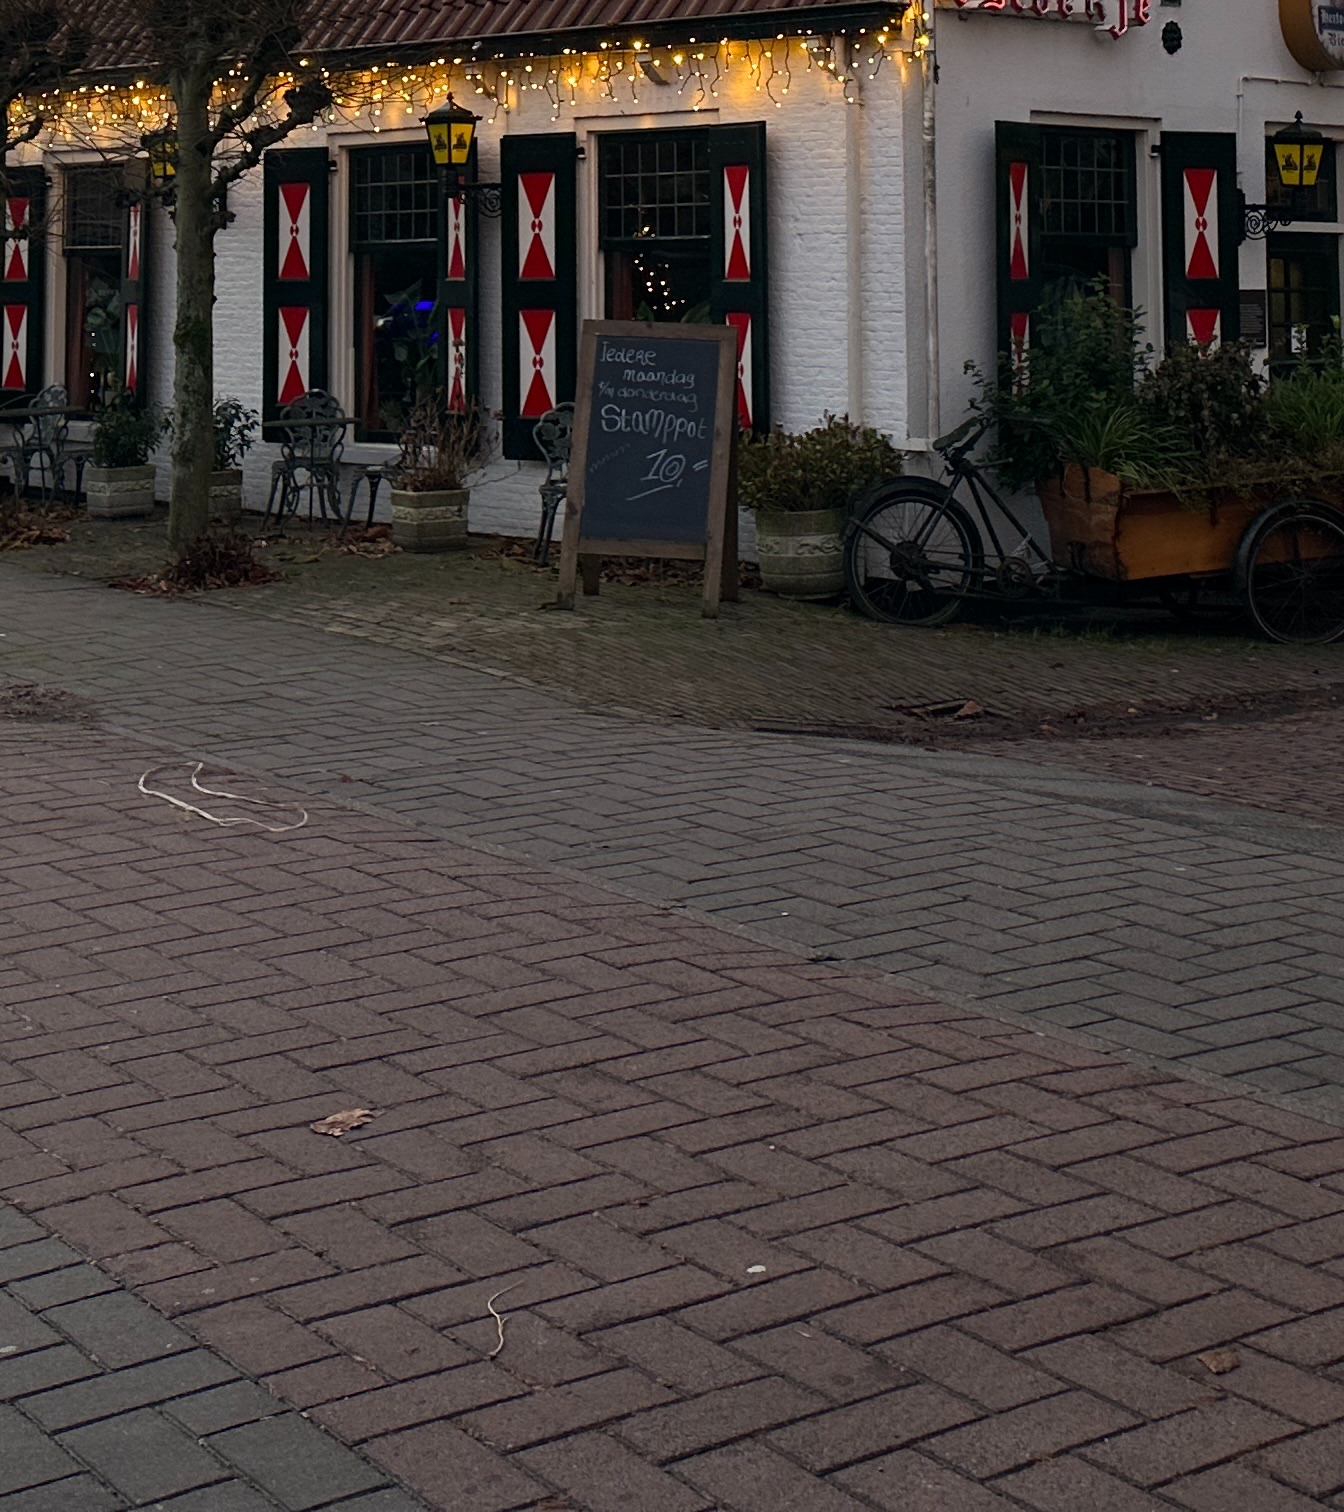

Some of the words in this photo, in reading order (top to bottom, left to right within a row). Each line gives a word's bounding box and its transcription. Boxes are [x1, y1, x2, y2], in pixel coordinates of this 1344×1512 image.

[622, 369, 696, 389] maandag
[617, 386, 699, 413] donderdag
[601, 404, 708, 444] Stamppot
